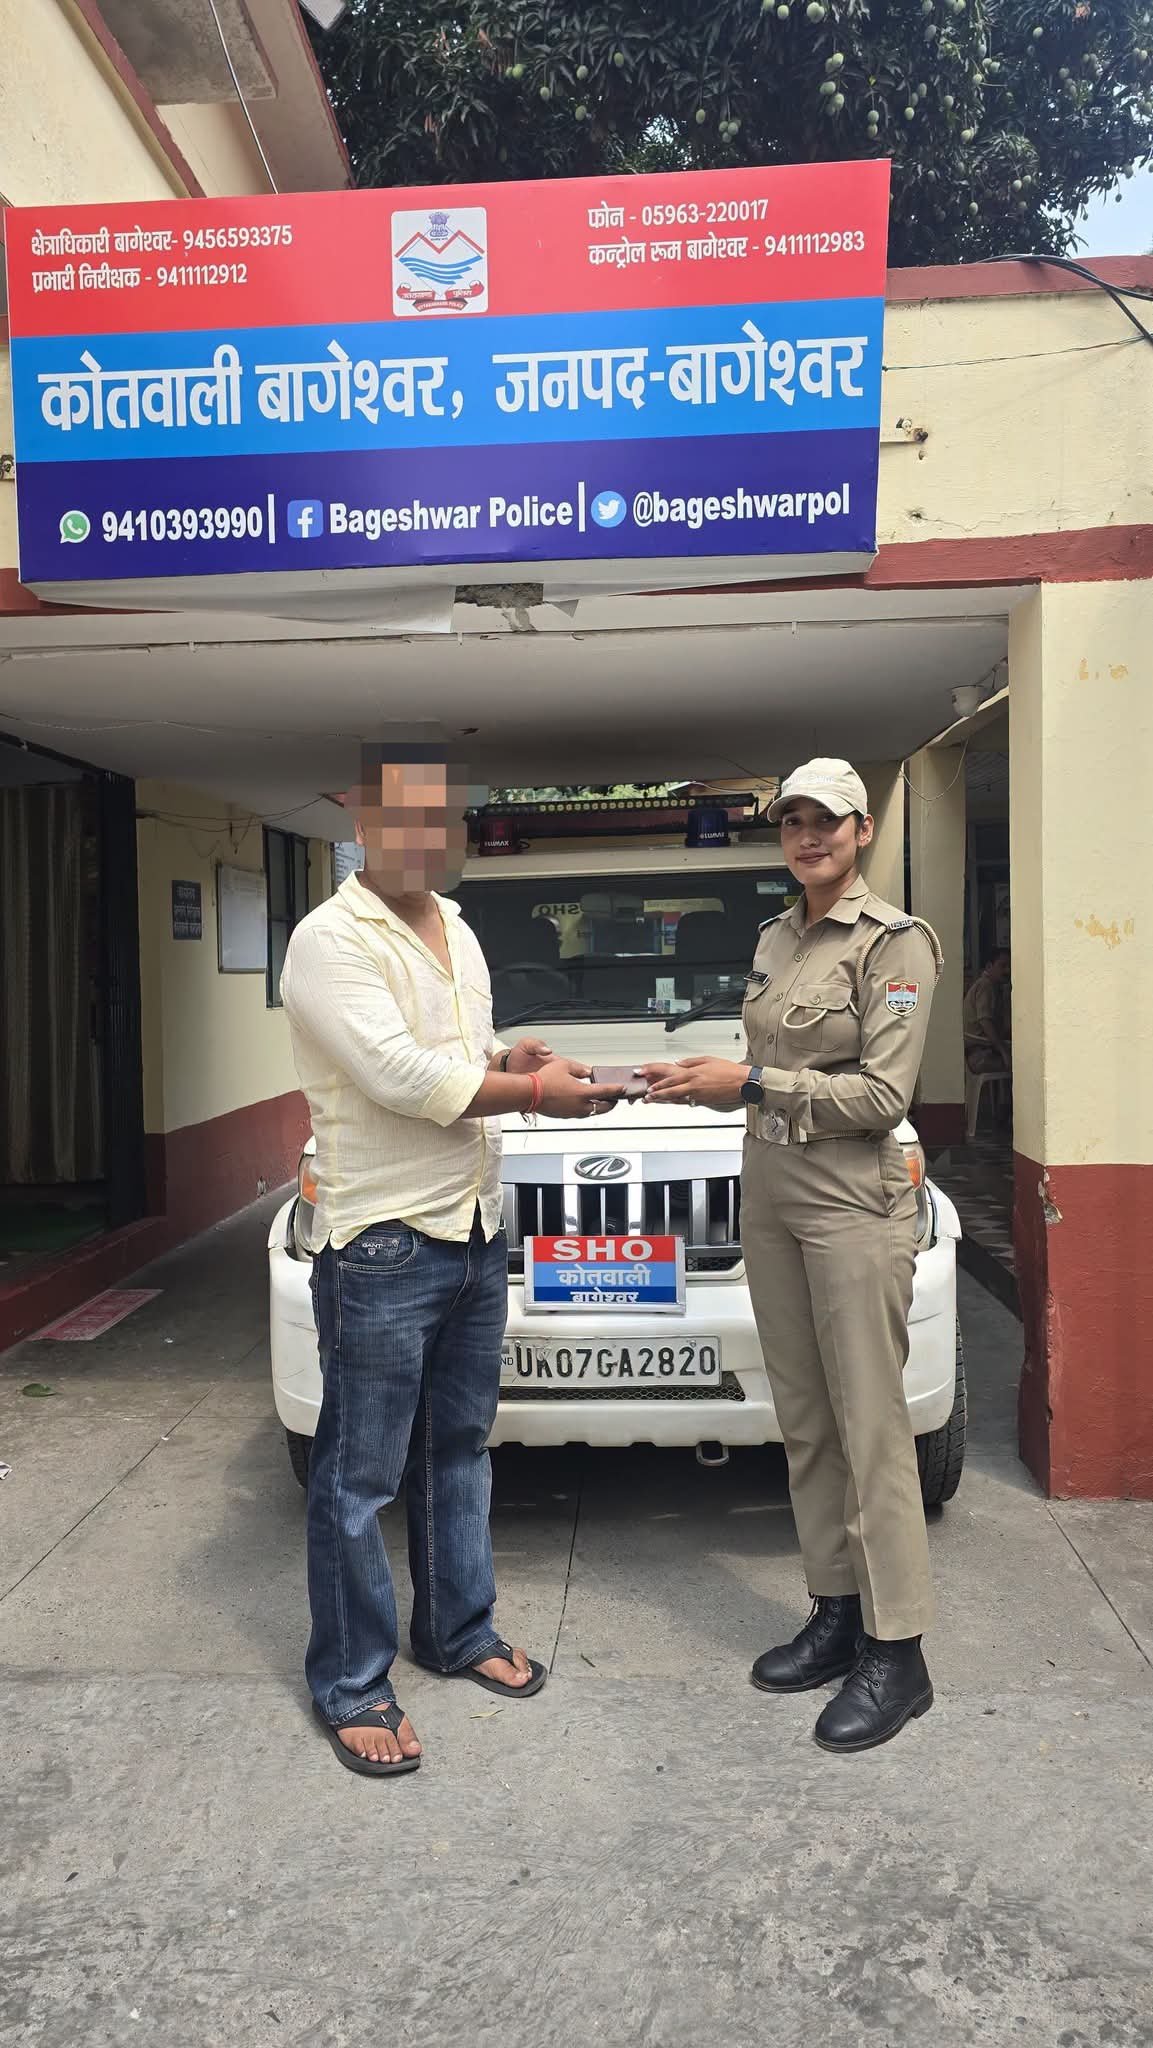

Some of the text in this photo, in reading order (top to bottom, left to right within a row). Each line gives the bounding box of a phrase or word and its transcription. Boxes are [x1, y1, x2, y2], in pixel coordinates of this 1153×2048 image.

[587, 200, 625, 228] फोन
[642, 199, 769, 226] 05963-220017
[31, 226, 110, 256] क्षेत्राधिकारी
[183, 224, 293, 250] 9456593375
[588, 236, 646, 269] कन्ट्रोल
[650, 241, 682, 262] रूम
[686, 231, 749, 260] बागेश्वर
[764, 230, 865, 256] 9411112983
[31, 263, 75, 293] प्रभारी
[78, 262, 142, 289] निरीक्षक
[156, 263, 248, 287] 9411112912
[37, 344, 243, 431] कोतवाली
[254, 339, 464, 425] बागेश्वर,
[329, 495, 573, 541] Bageshwar Police
[632, 482, 850, 529] @bageshwarpol
[102, 506, 263, 543] 9410393990
[552, 1239, 653, 1261] SHO
[556, 1263, 651, 1286] कोतवाली
[501, 1357, 514, 1366] ND
[516, 1346, 716, 1378] UK07GA2820
